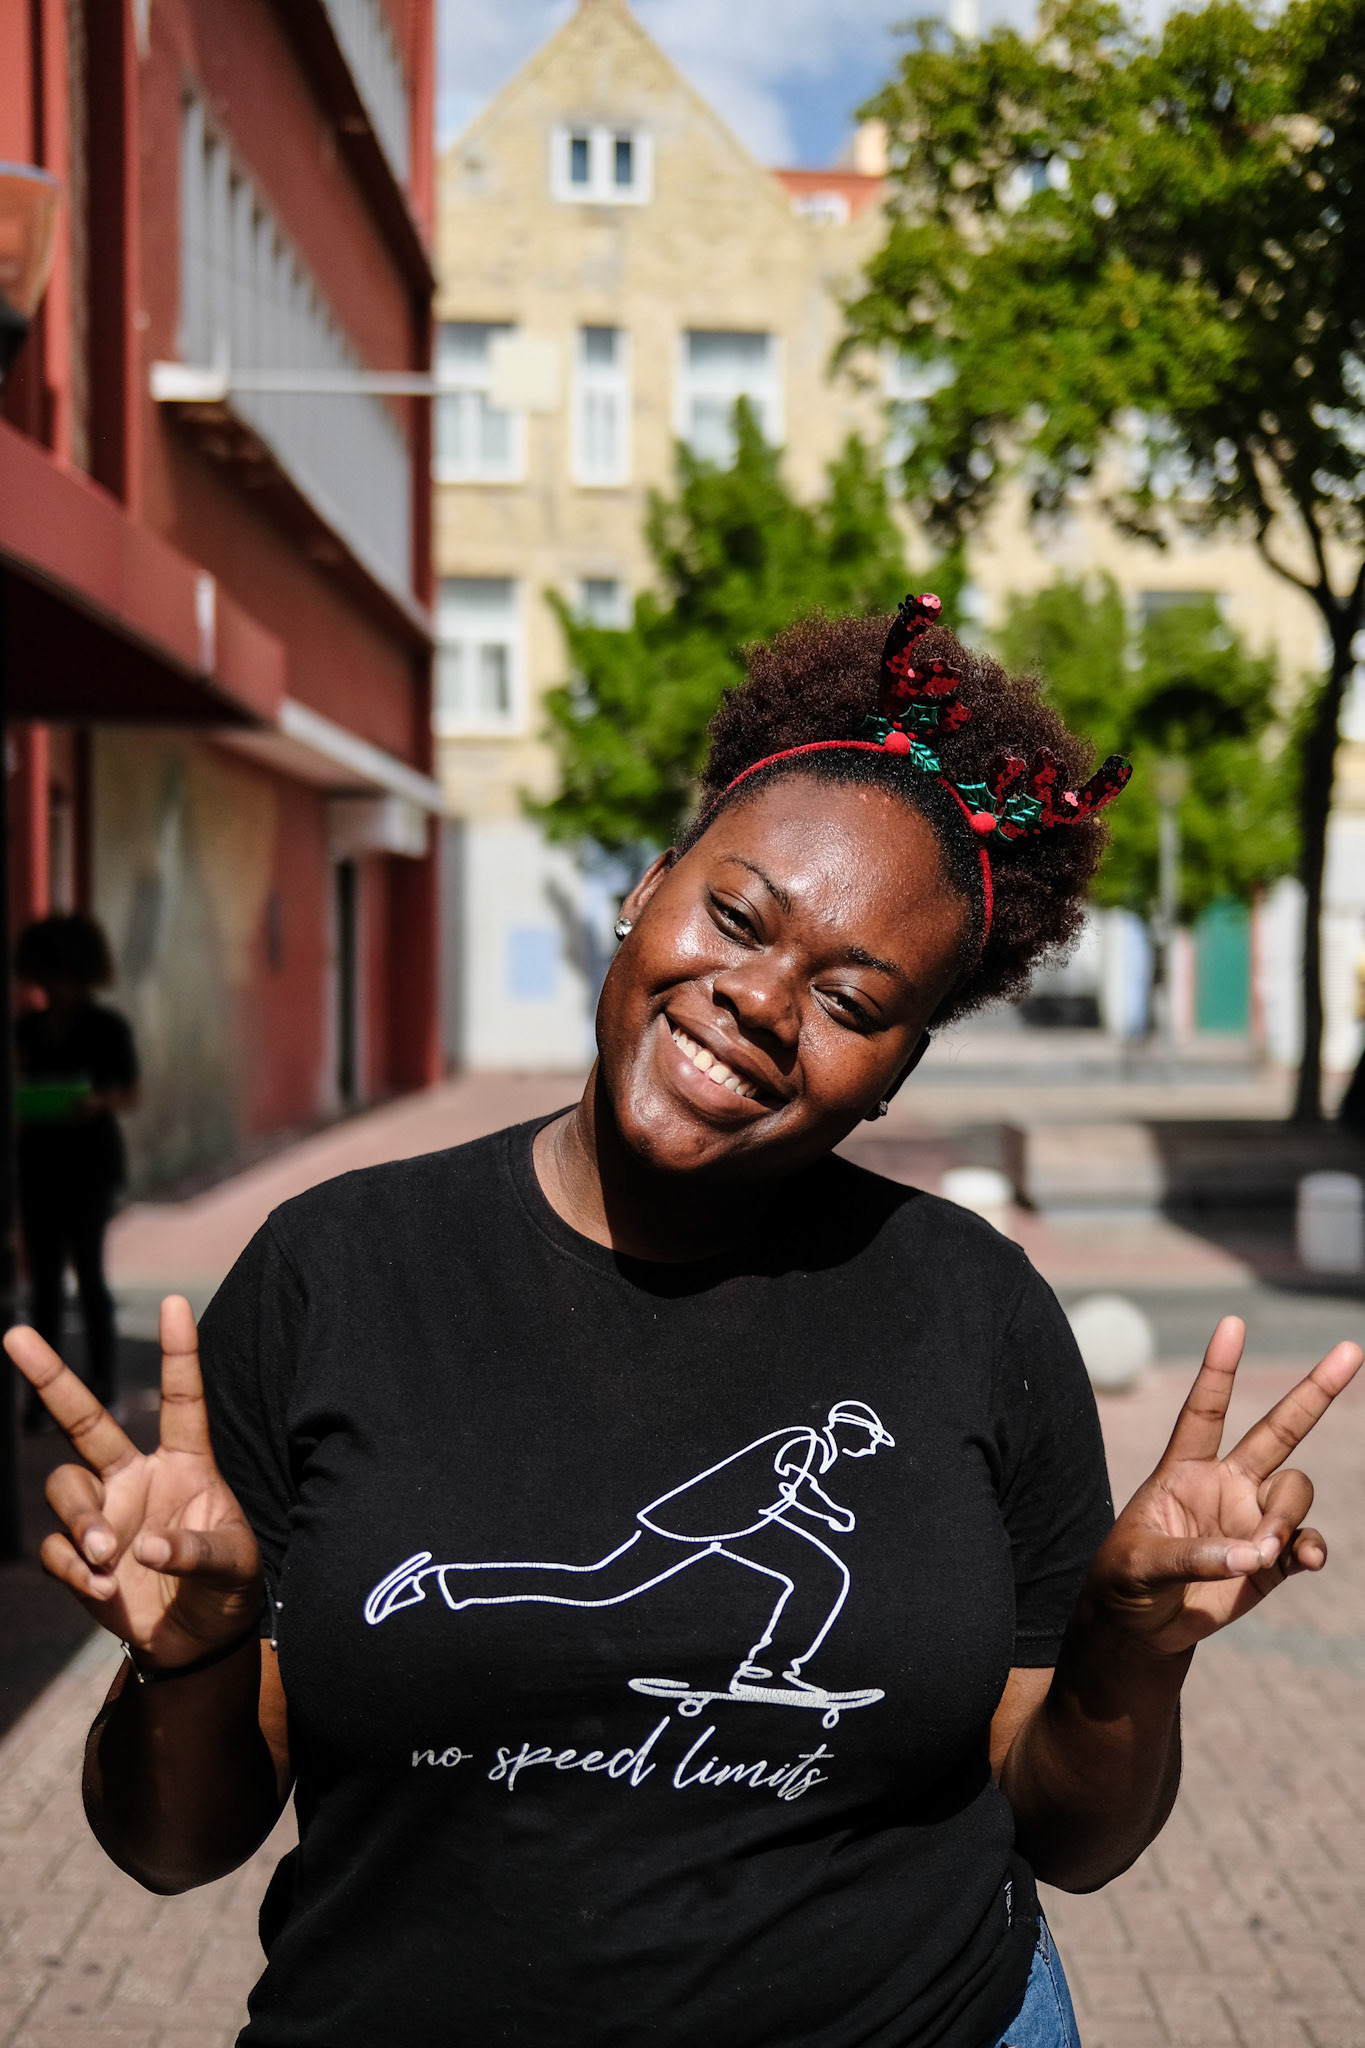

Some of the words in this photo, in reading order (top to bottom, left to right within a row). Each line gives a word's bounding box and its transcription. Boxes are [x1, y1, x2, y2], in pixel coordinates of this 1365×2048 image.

[411, 1746, 473, 1767] no
[488, 1715, 671, 1792] speed
[673, 1725, 835, 1801] limits
